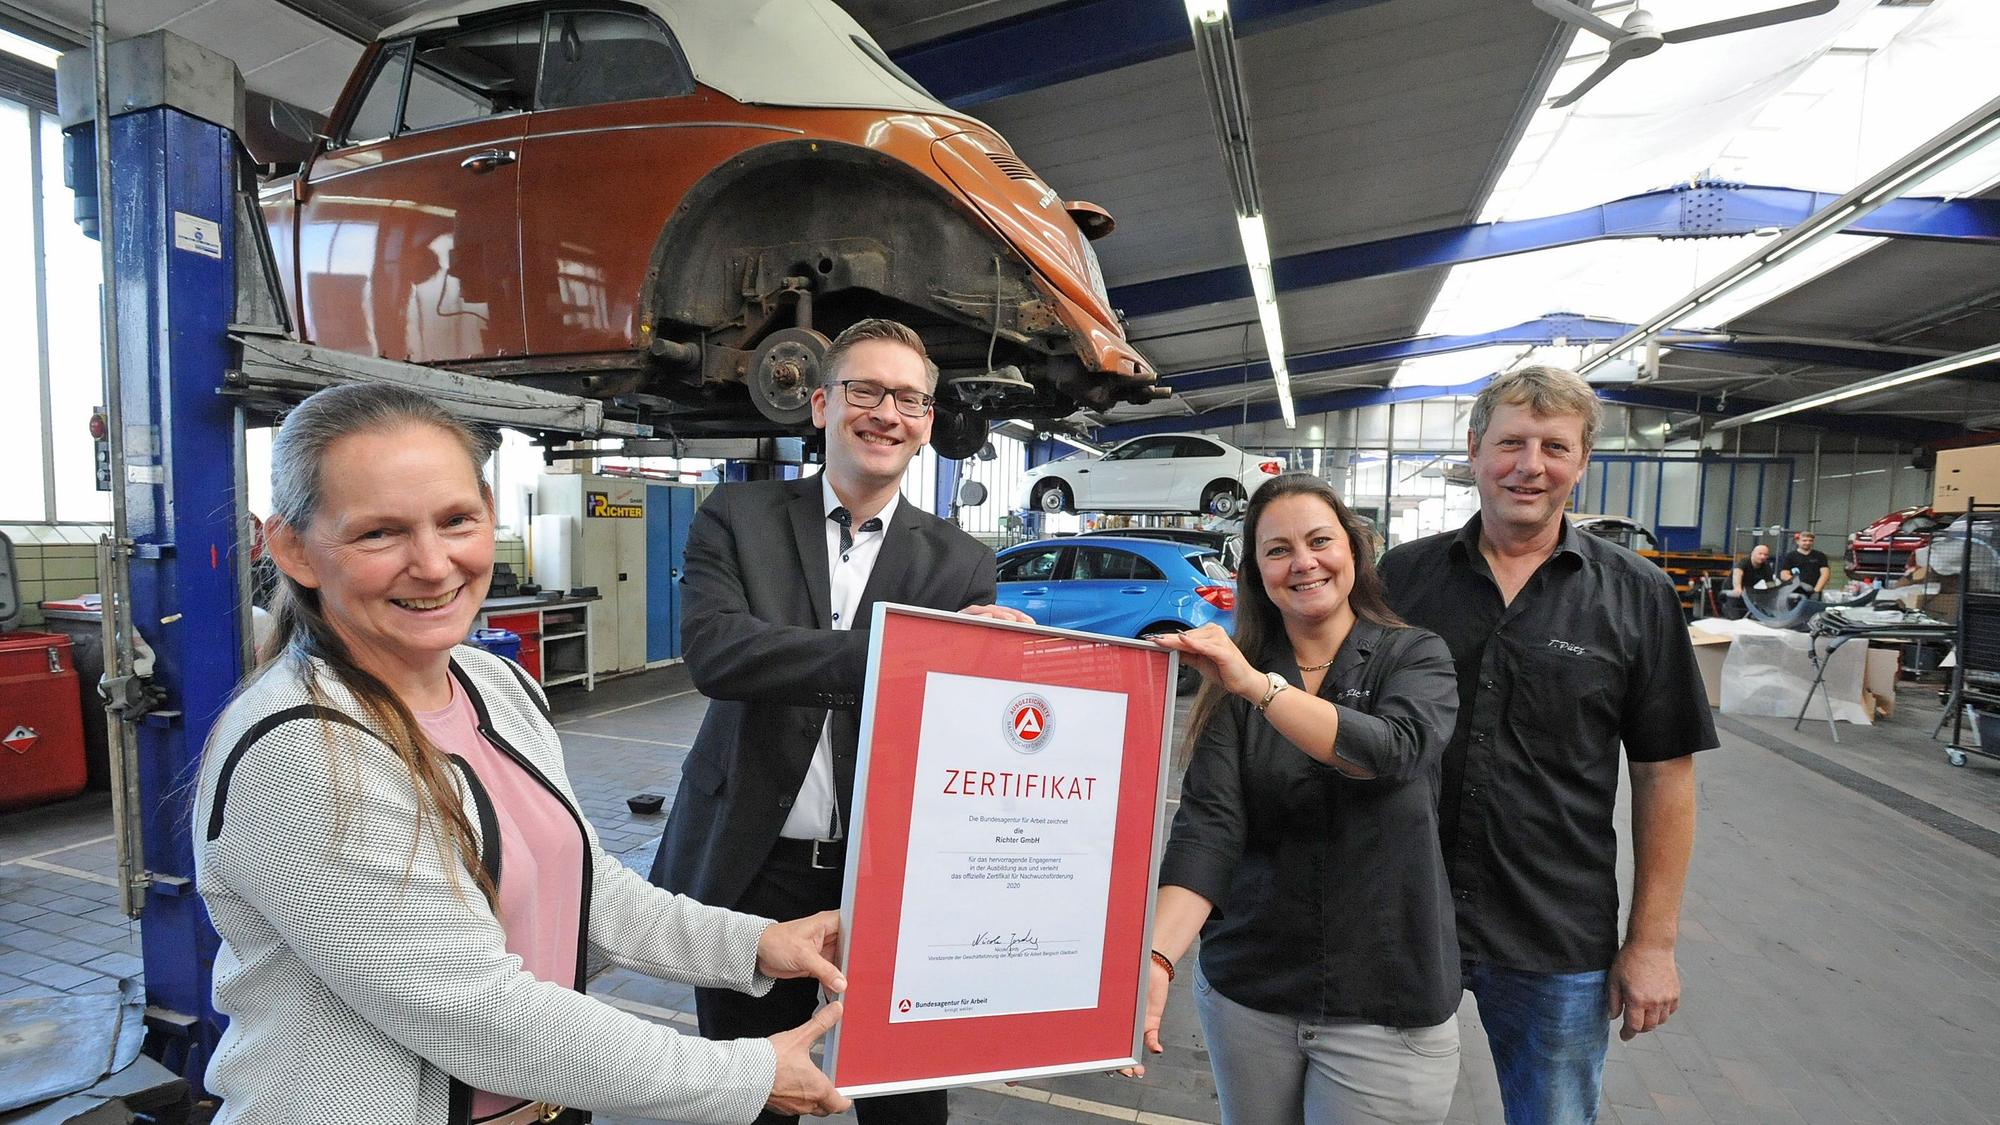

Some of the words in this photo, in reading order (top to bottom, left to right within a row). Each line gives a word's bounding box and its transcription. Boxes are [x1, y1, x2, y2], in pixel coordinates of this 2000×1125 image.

[595, 495, 642, 517] RICHTER
[1010, 698, 1050, 718] AUSGEZEICHNETE
[1007, 721, 1051, 750] NACHWUCHSFÖRDERUNG
[943, 769, 1096, 800] ZERTIFIKAT
[916, 1000, 959, 1008] Bundesagentur
